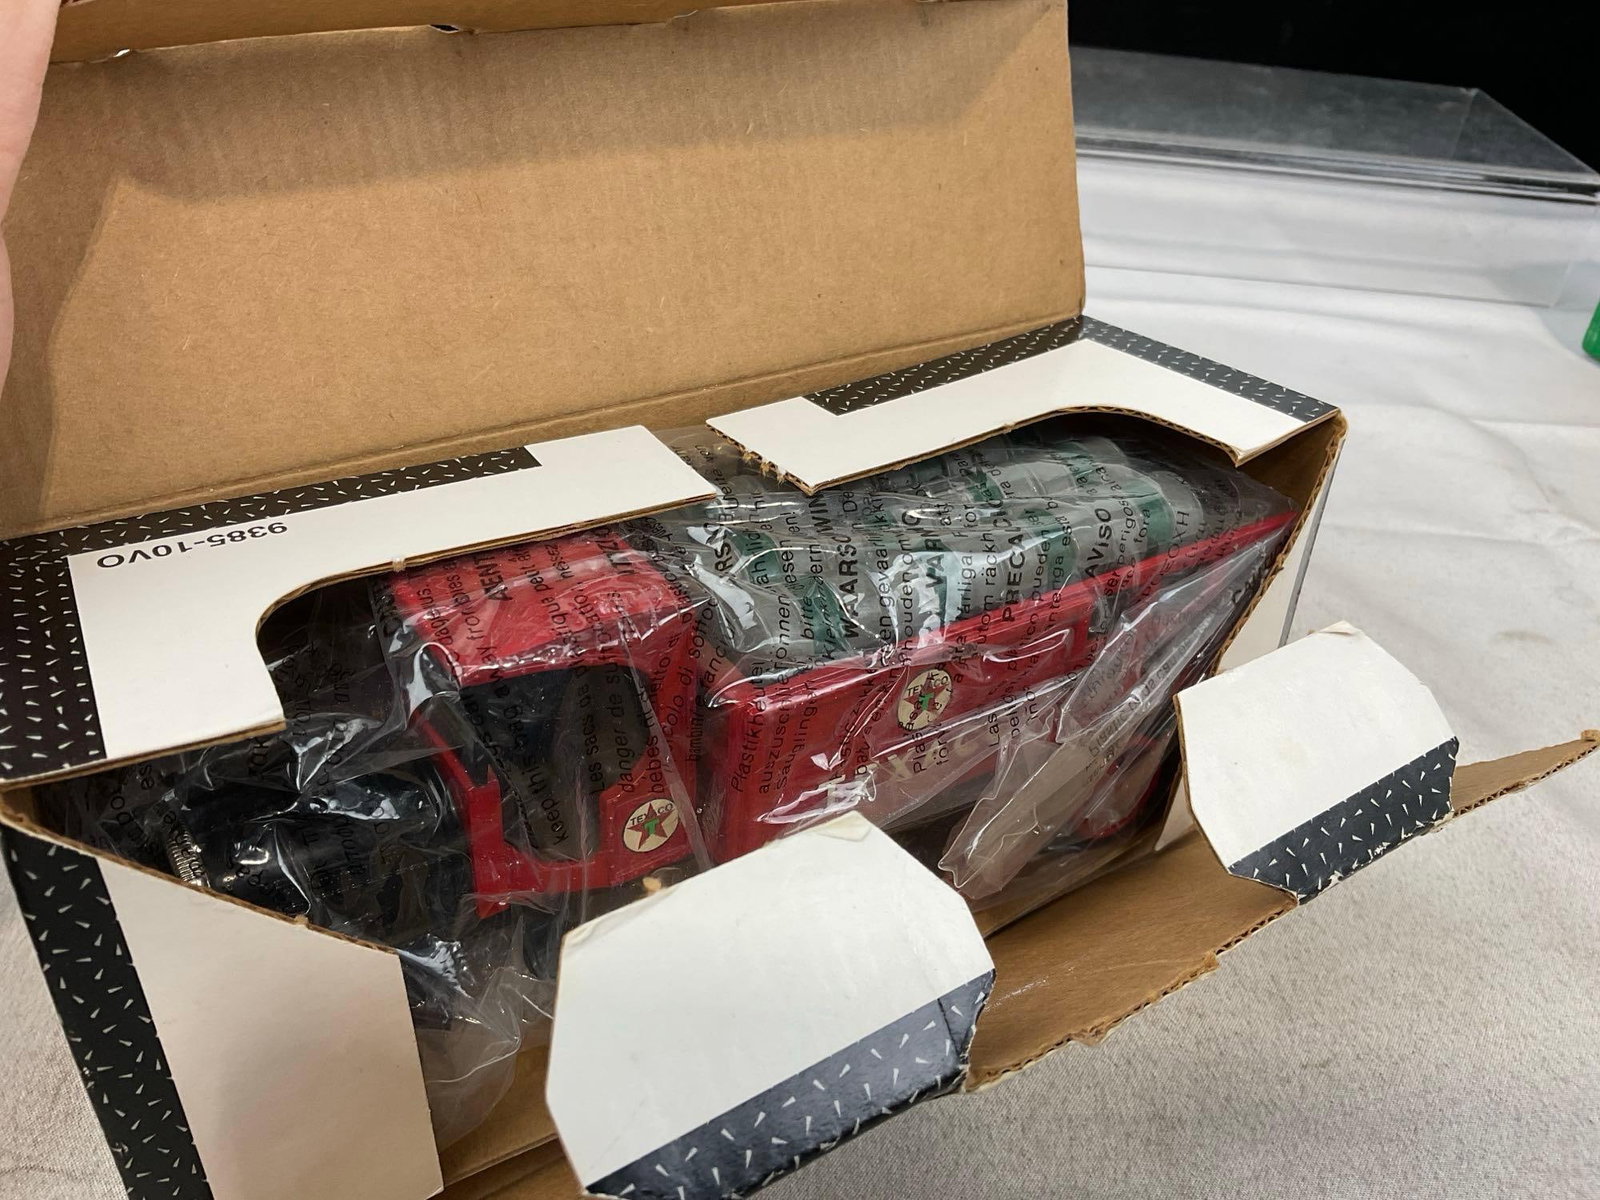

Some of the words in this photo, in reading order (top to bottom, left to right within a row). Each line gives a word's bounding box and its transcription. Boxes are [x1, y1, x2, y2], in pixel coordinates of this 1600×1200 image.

[97, 521, 288, 568] 9385-10VO
[1133, 508, 1151, 544] fora
[800, 596, 815, 640] bitte
[976, 595, 993, 645] utom
[678, 667, 693, 685] di
[607, 694, 625, 717] de
[582, 715, 598, 756] sacs
[987, 713, 1000, 746] Las
[589, 762, 605, 793] Les
[613, 728, 635, 792] danger
[540, 799, 570, 844] keep
